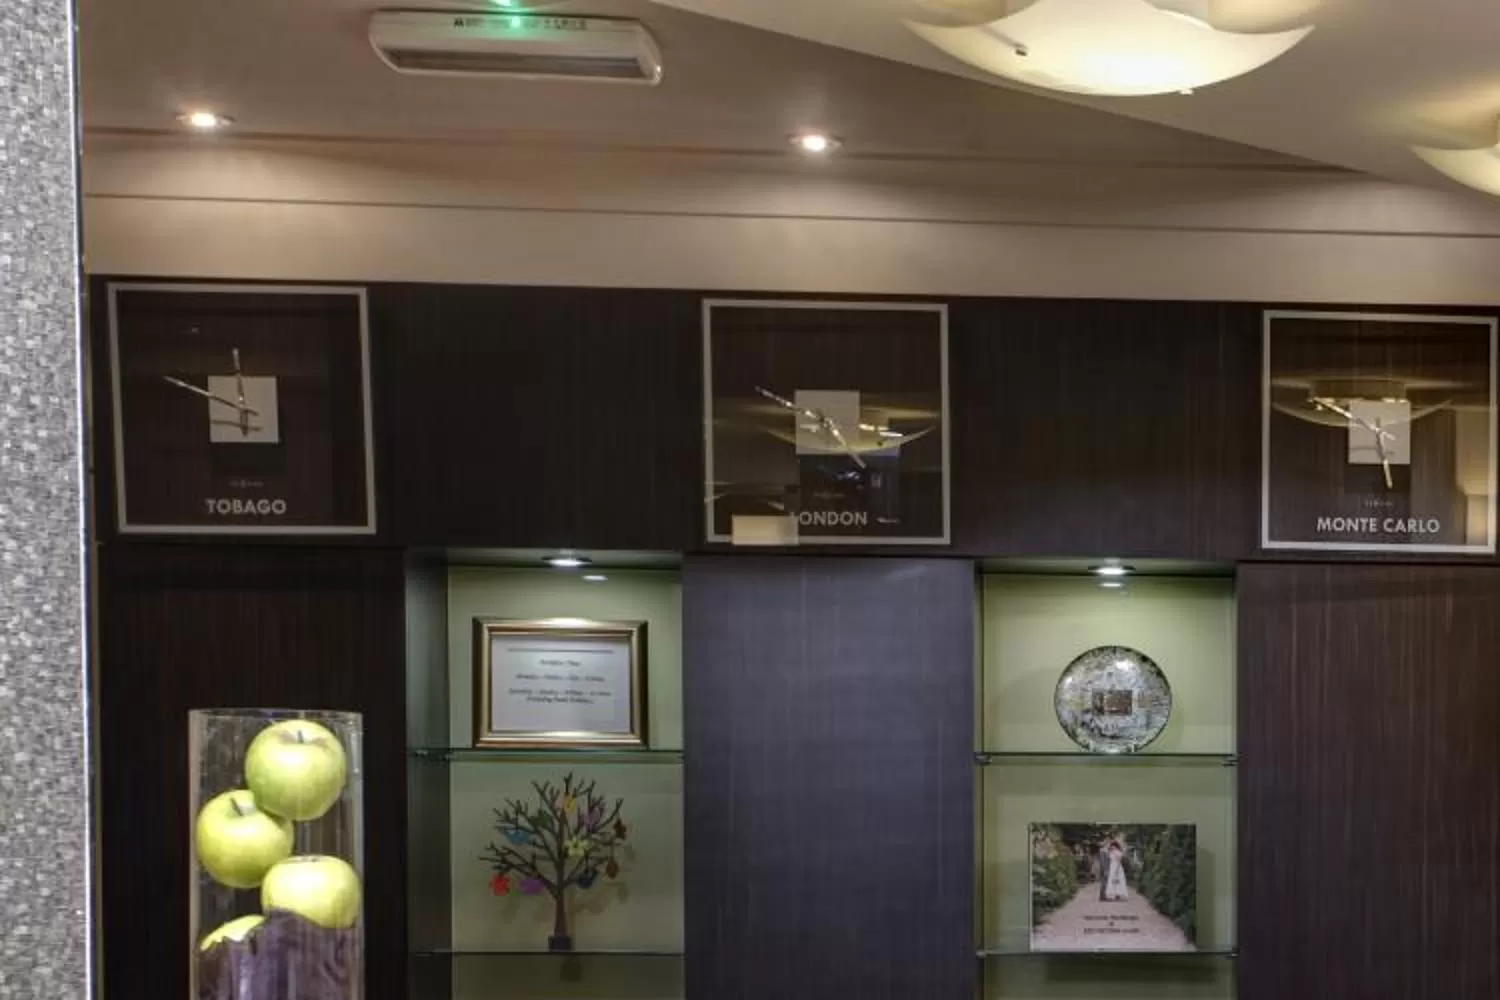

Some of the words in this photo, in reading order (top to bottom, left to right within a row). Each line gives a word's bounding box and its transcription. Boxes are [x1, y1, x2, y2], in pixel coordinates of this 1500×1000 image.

[204, 499, 287, 515] TOBAGO
[1316, 517, 1378, 533] MONTE
[1382, 518, 1441, 534] CARLO
